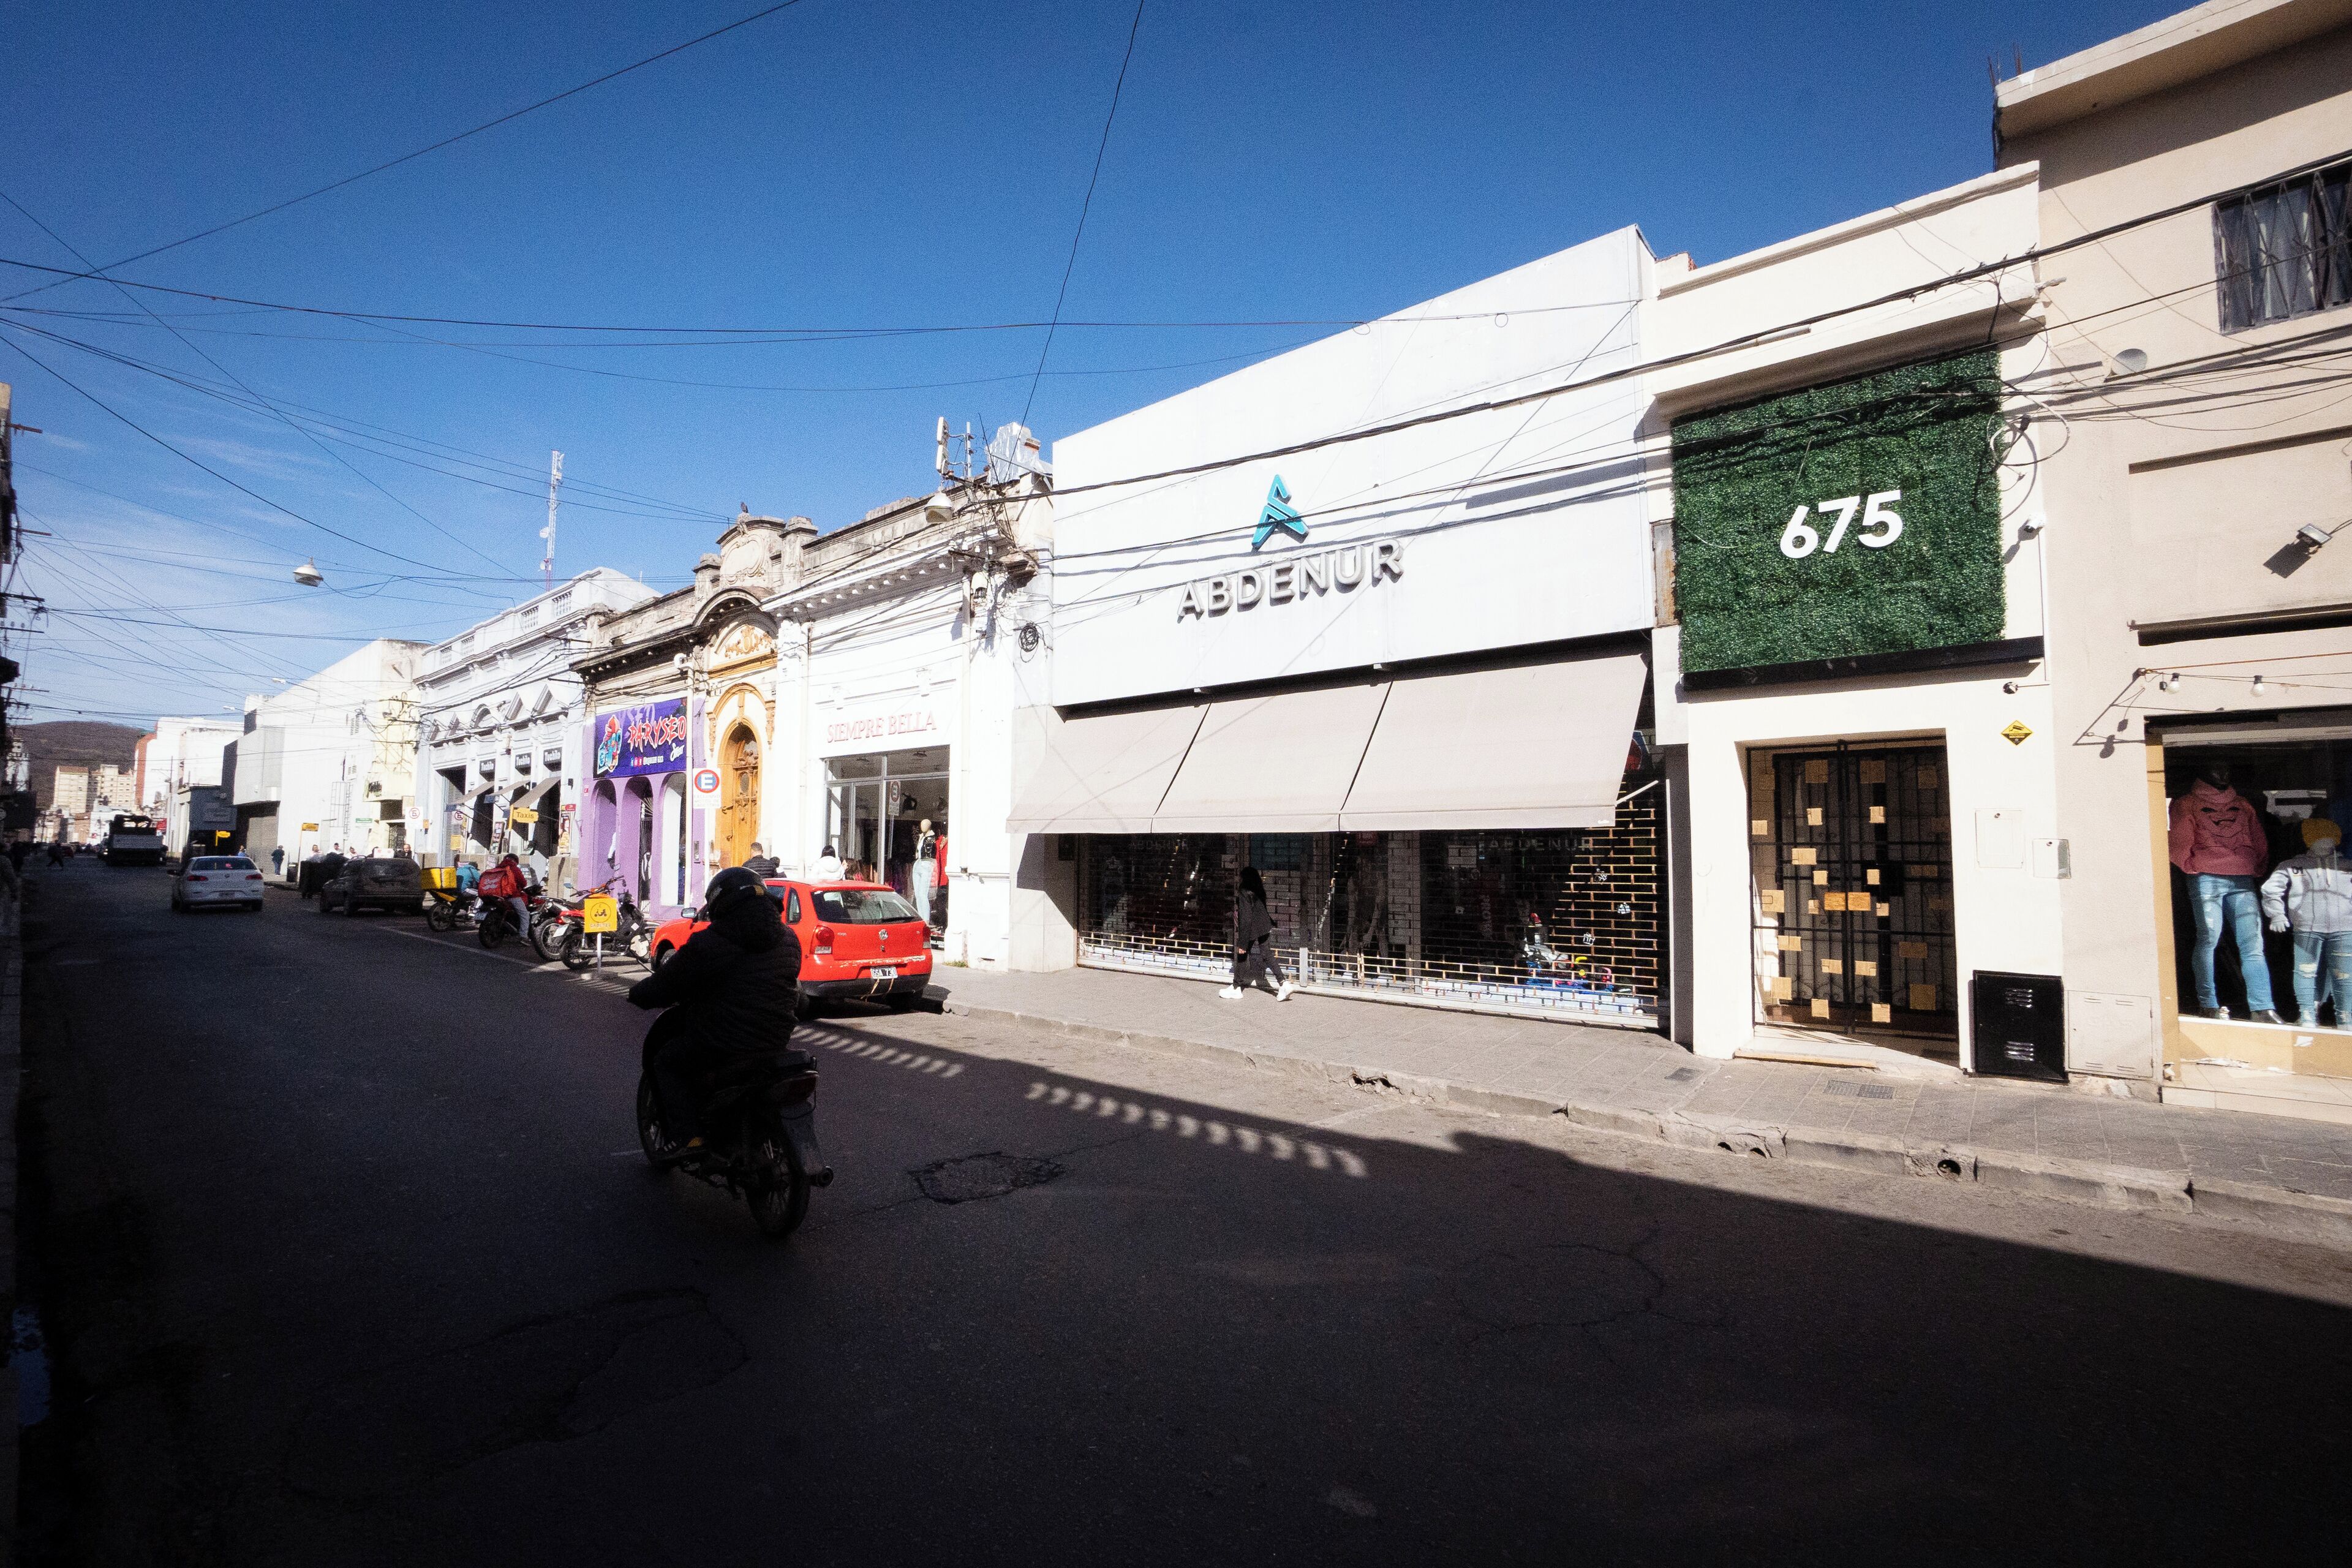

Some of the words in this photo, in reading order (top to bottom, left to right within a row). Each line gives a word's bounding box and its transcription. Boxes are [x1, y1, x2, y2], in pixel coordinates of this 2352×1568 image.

[1780, 489, 1904, 559] 675
[1177, 538, 1403, 619] ABDENUR
[627, 715, 687, 753] PARYSEO
[827, 717, 884, 743] SIEMPRE
[888, 711, 937, 735] BELLA
[701, 774, 713, 789] E
